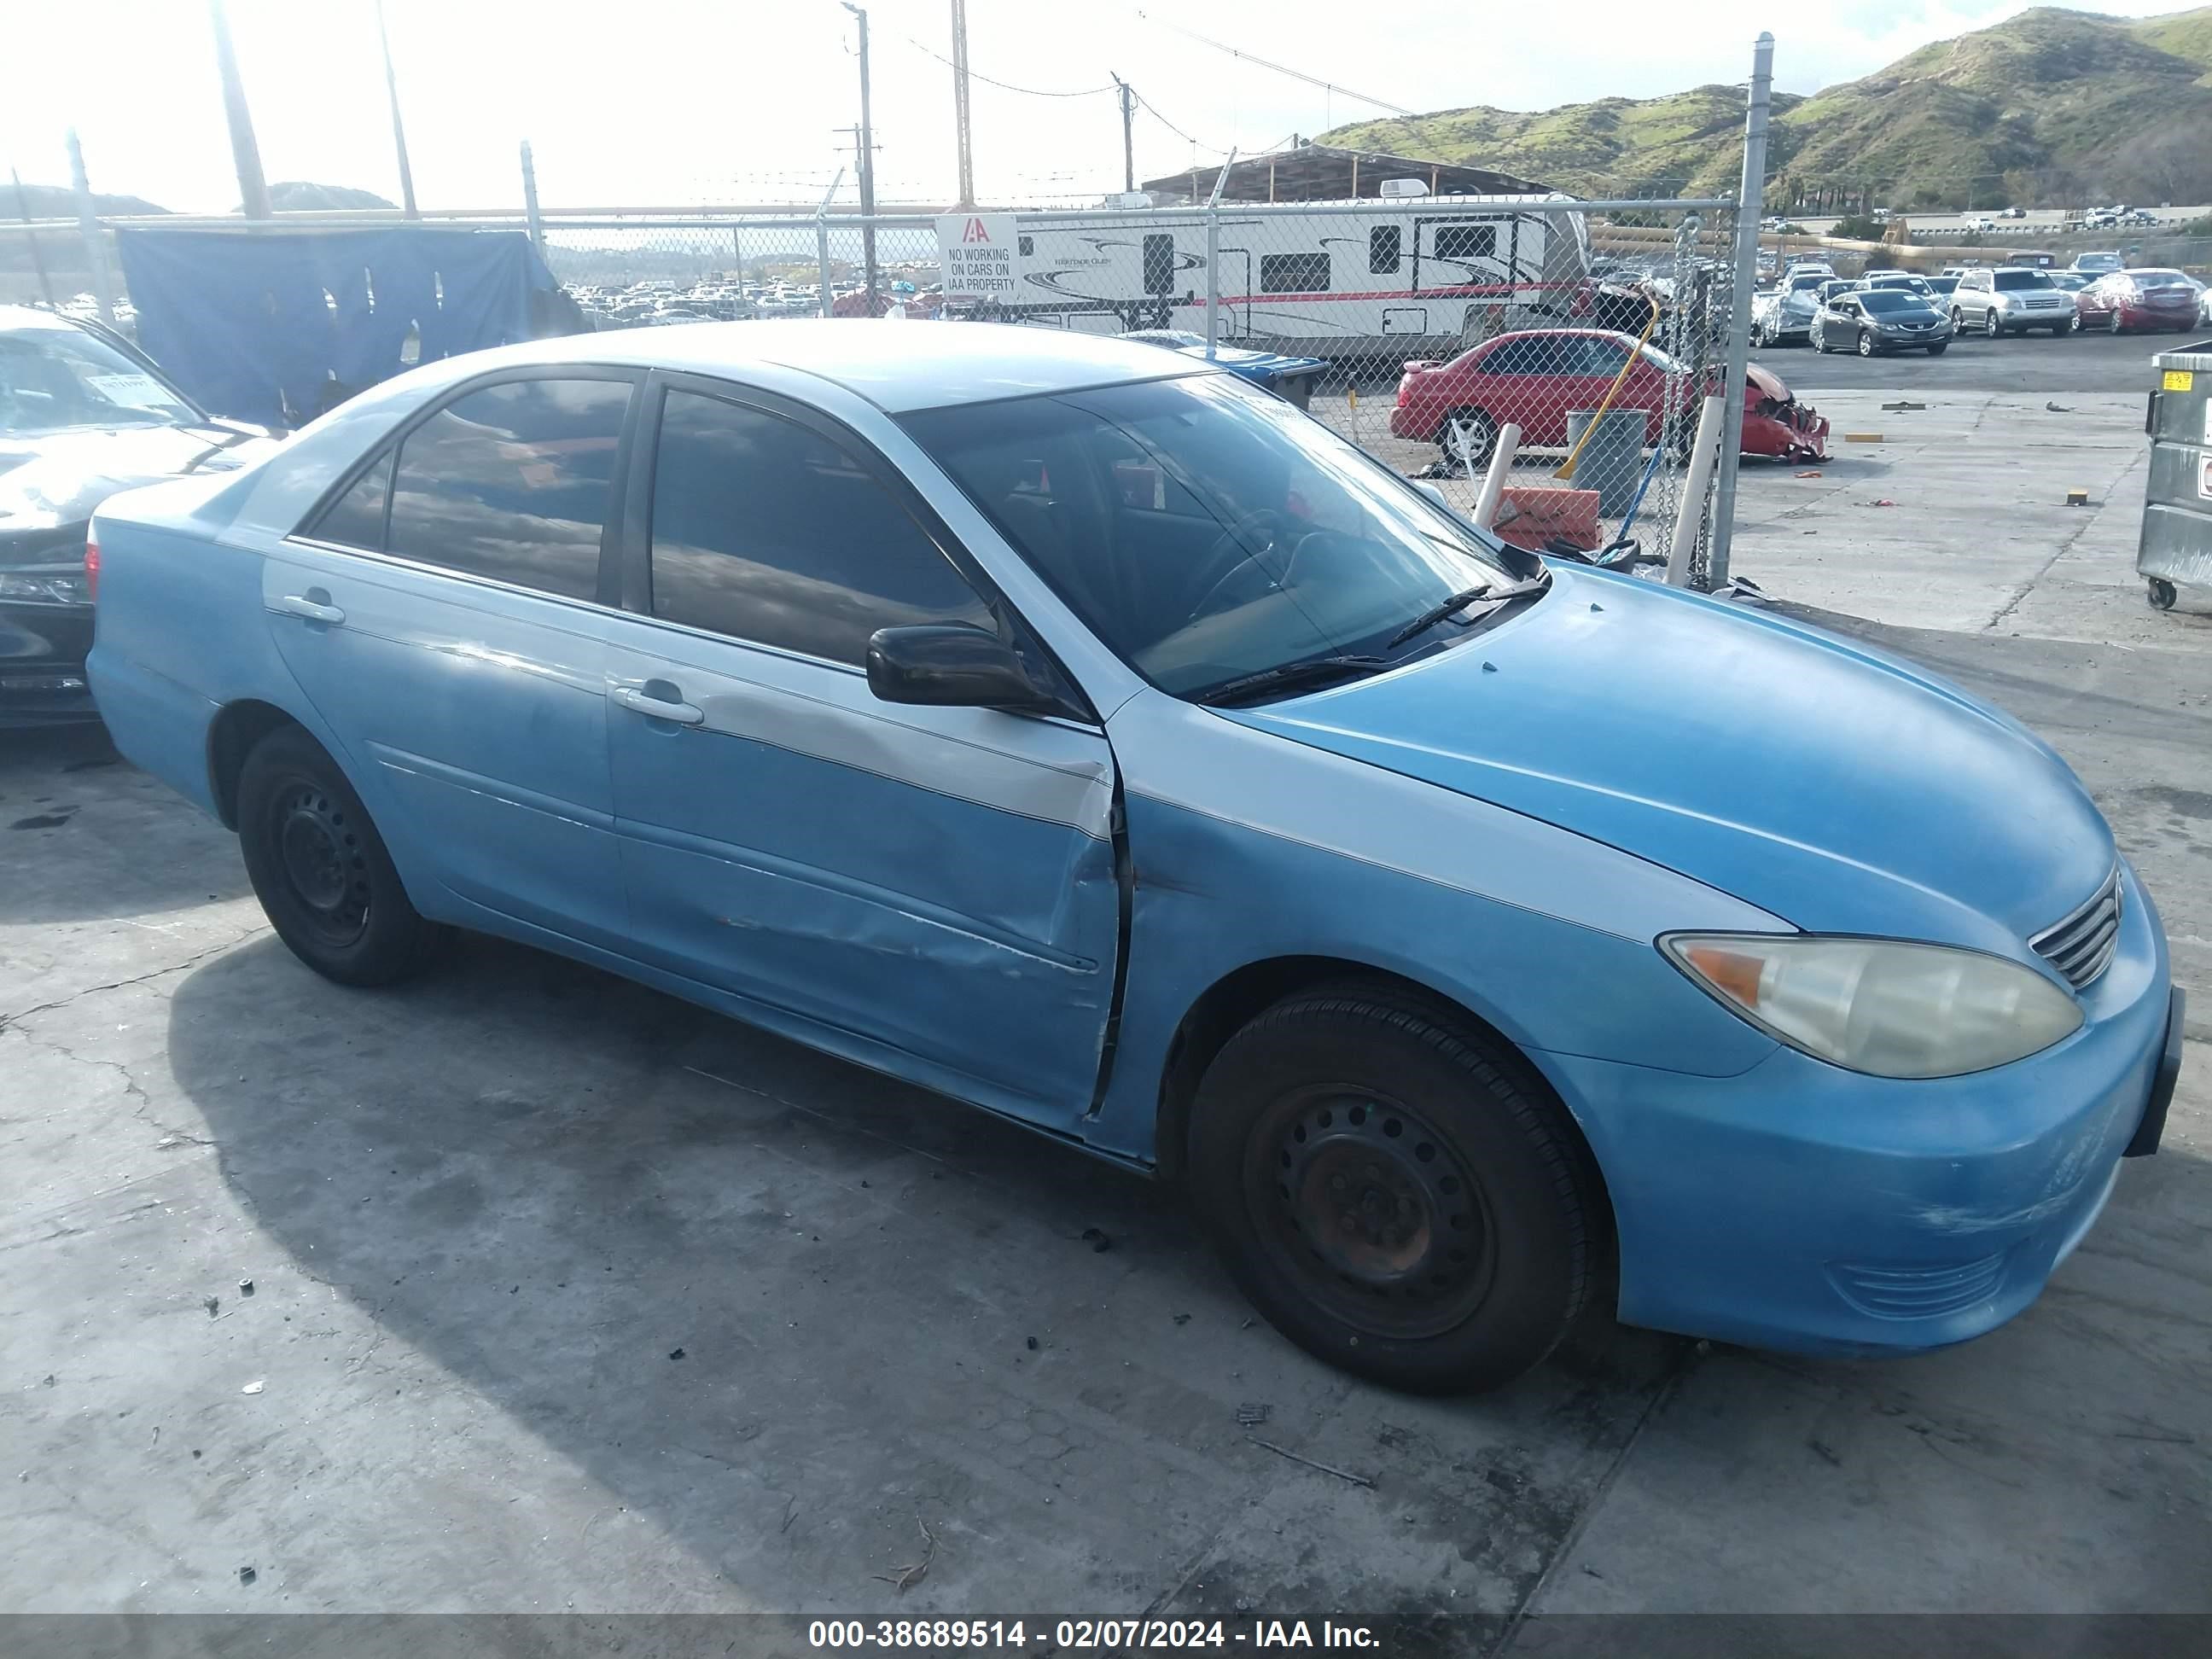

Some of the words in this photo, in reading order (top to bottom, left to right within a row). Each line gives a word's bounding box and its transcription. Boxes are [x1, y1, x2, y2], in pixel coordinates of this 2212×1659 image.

[948, 248, 962, 261] NO
[964, 248, 1010, 261] WORKING
[952, 264, 964, 276] ON
[968, 264, 992, 276] CARS
[996, 264, 1010, 276] ON
[948, 278, 964, 290] IAA
[967, 278, 1016, 290] PROPERTY
